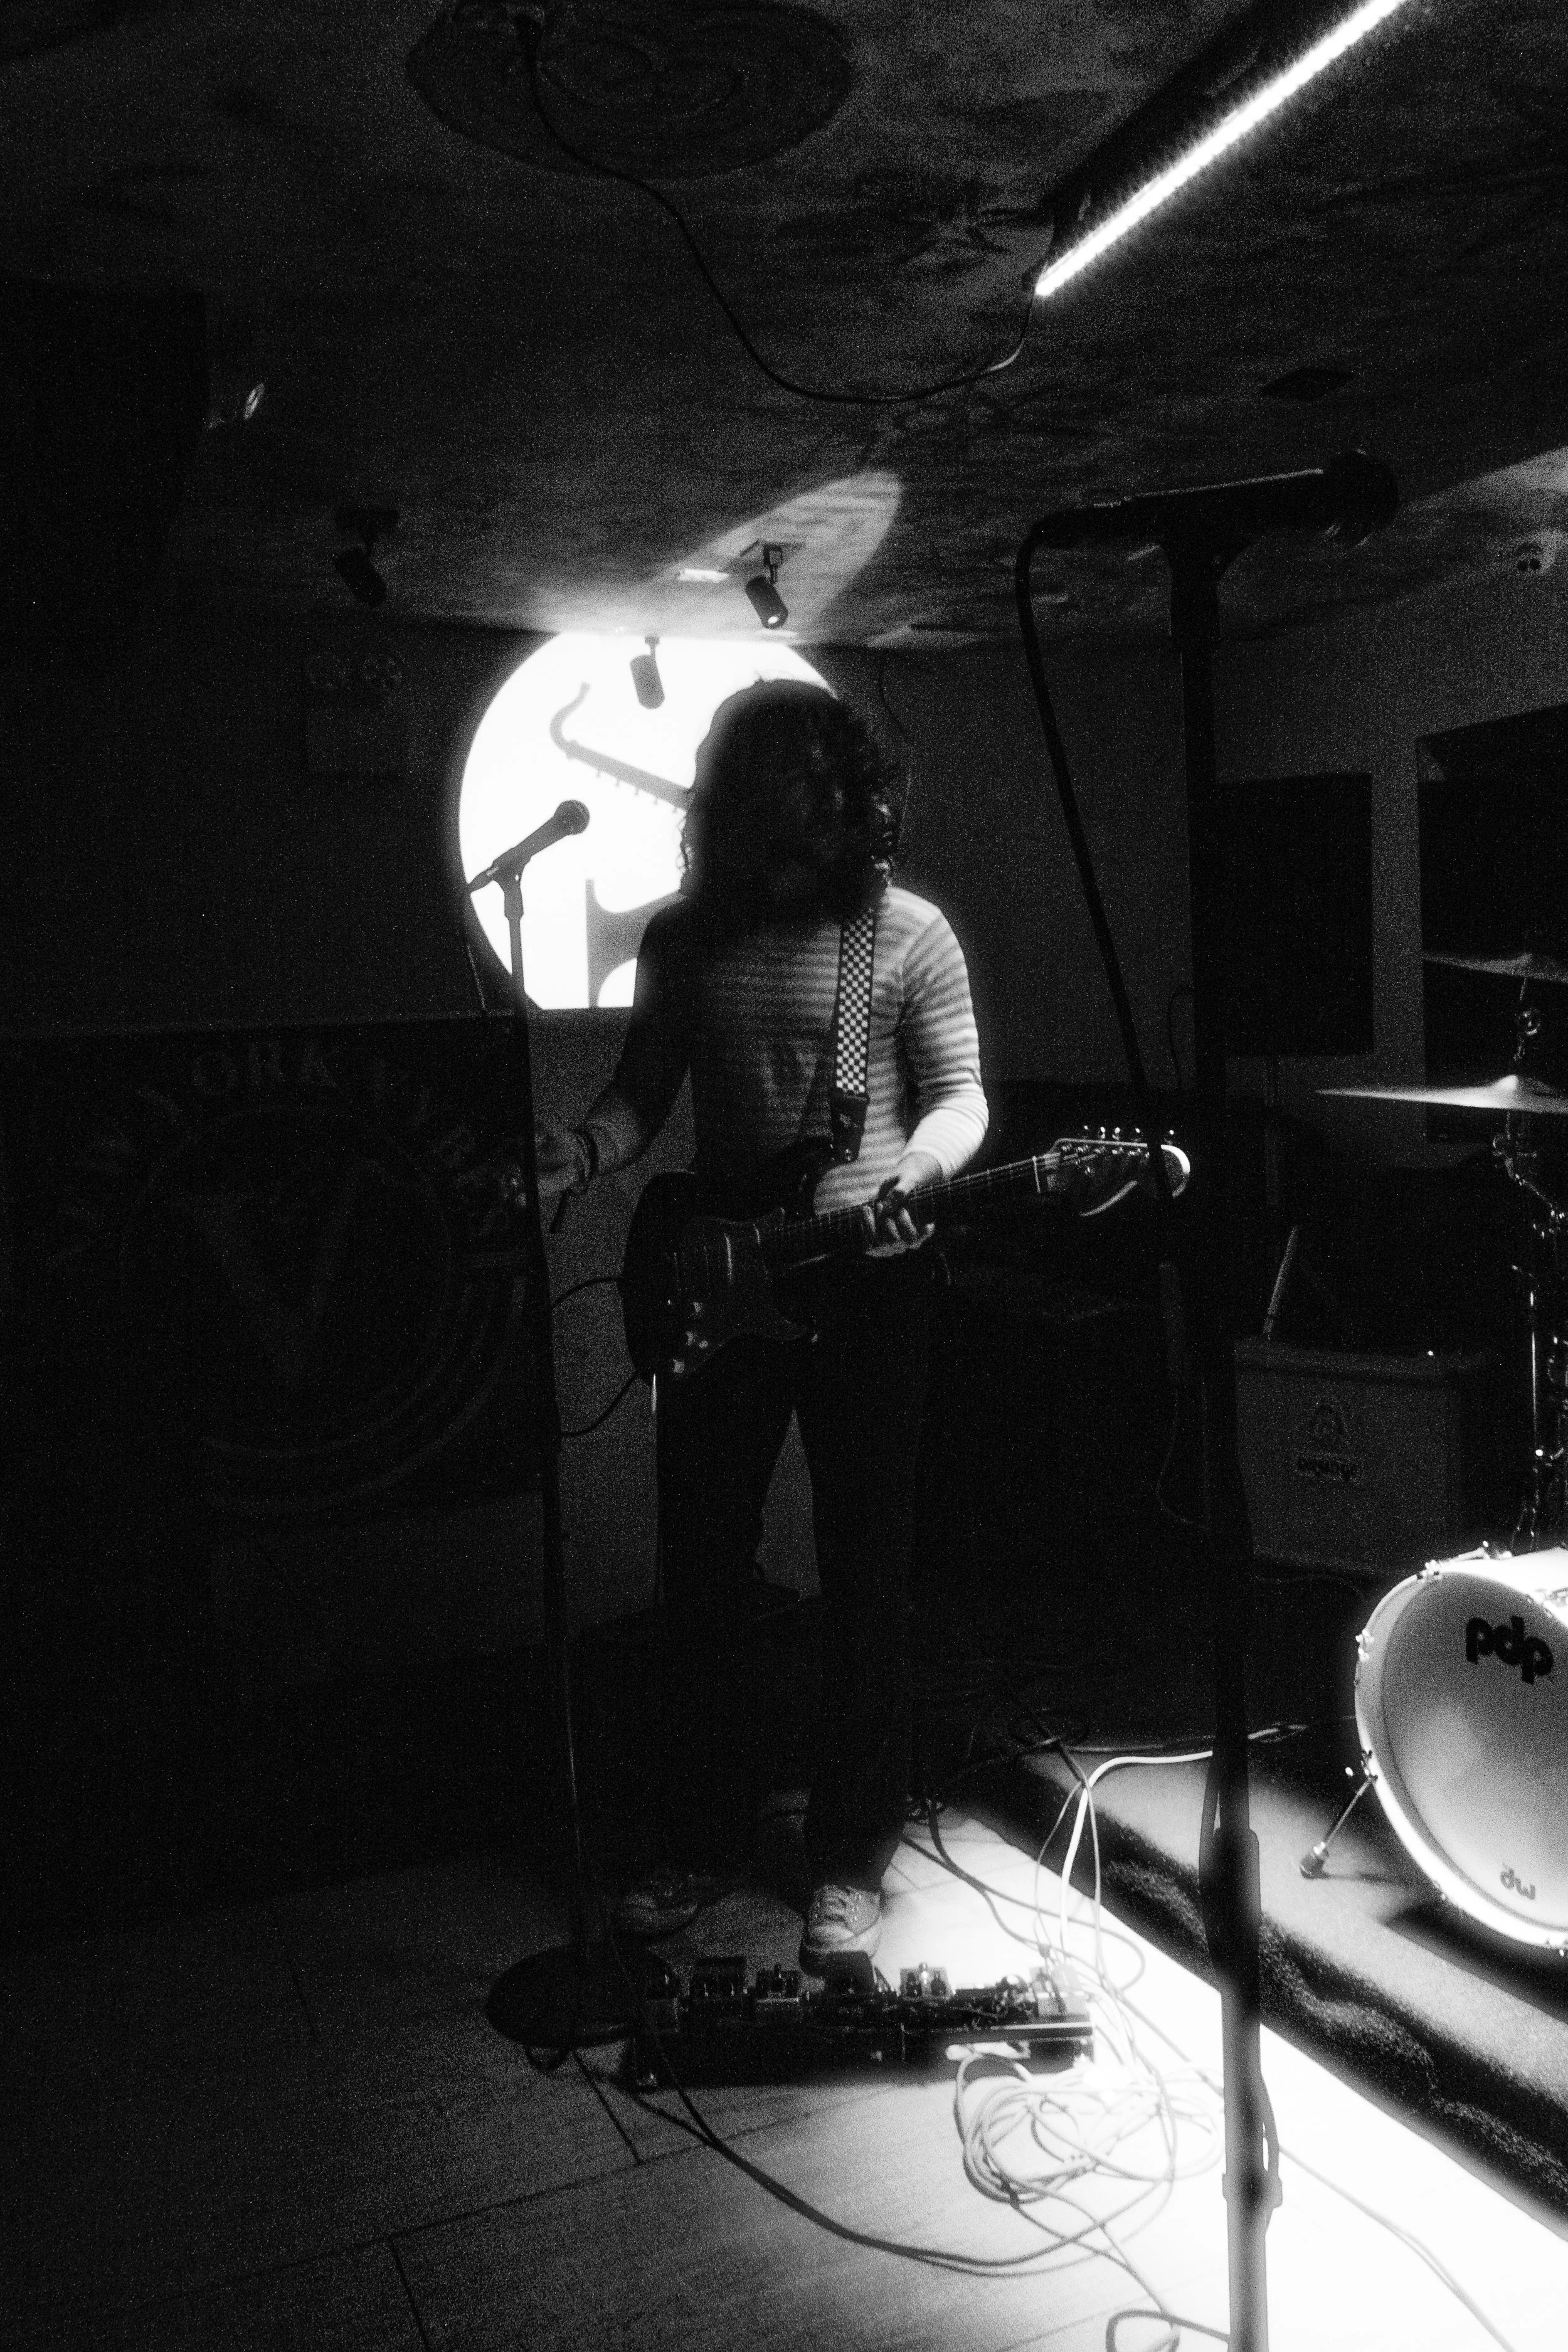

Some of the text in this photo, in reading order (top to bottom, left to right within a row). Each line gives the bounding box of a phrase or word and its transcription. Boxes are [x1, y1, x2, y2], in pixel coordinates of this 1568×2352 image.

[135, 1039, 340, 1125] YORK
[1466, 1615, 1554, 1685] pdp
[1500, 1868, 1536, 1900] dw
